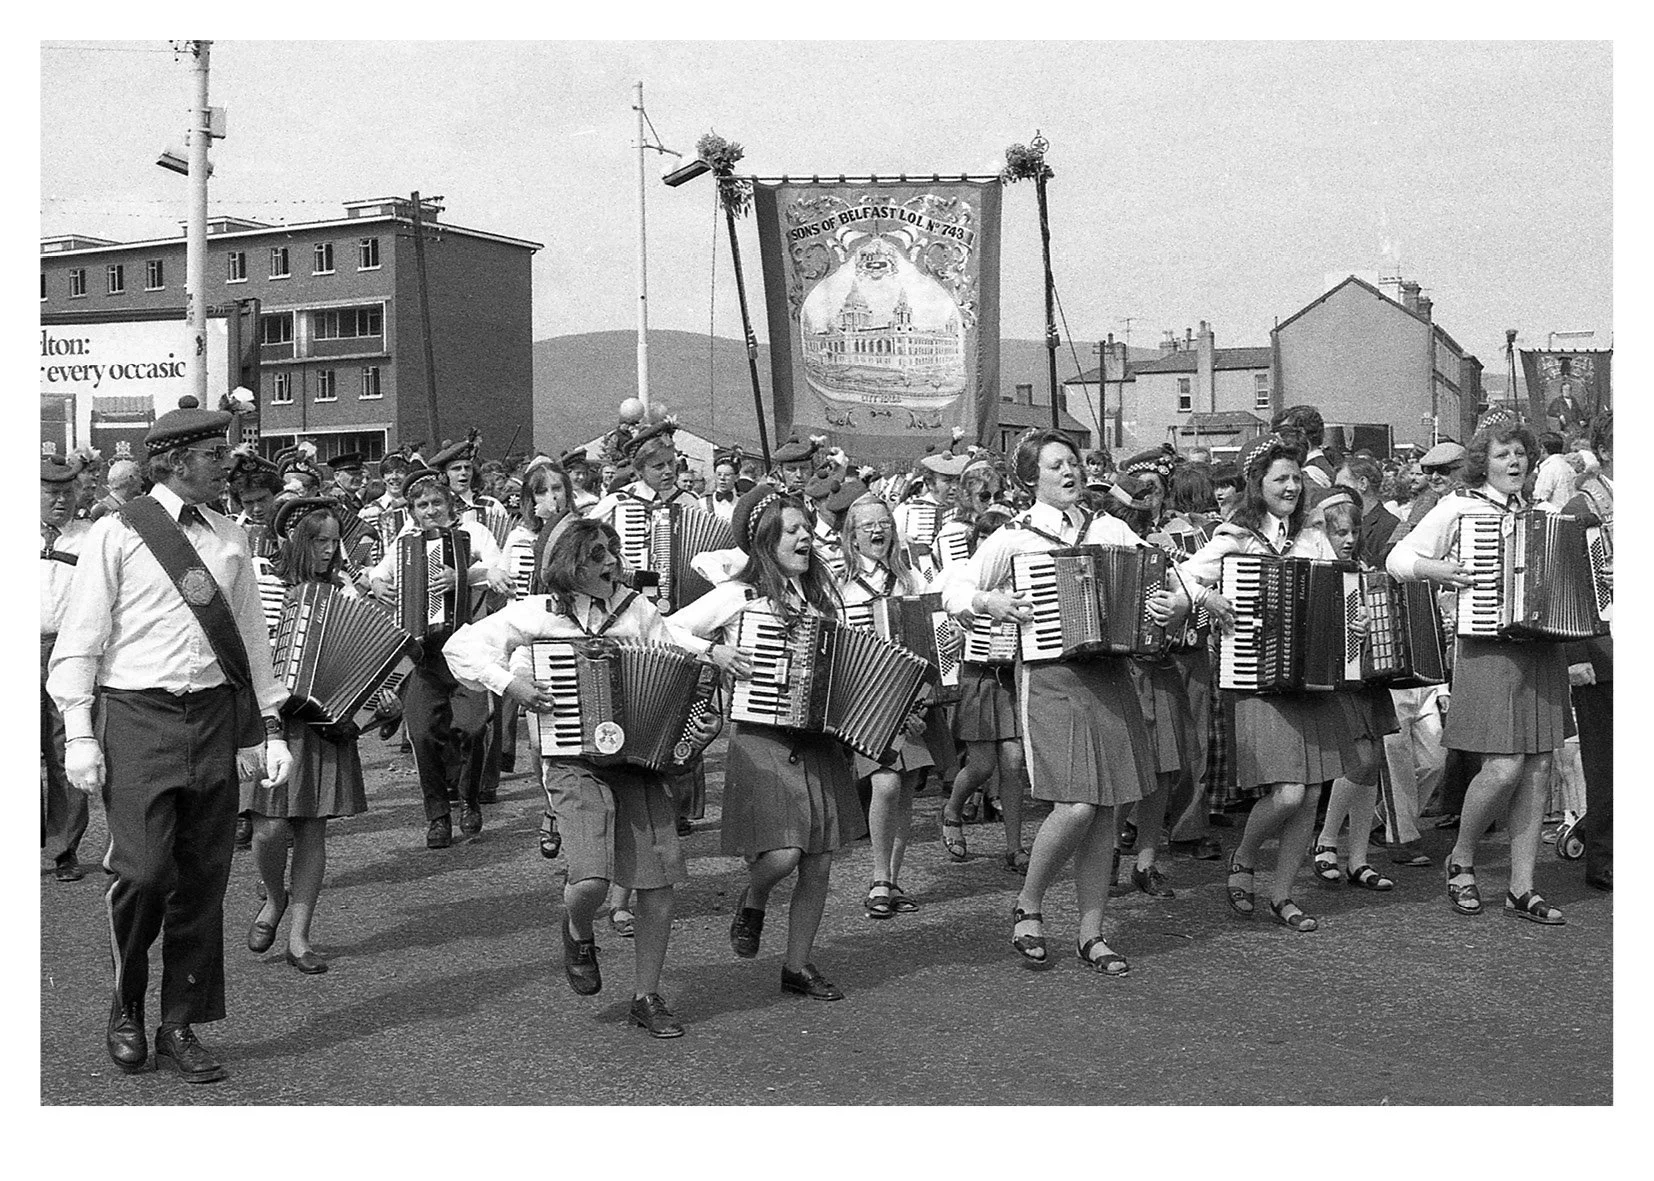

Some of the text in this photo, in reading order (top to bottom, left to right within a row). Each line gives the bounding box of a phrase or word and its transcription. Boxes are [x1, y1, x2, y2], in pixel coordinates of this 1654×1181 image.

[790, 223, 820, 241] SONS
[821, 216, 836, 231] OF
[838, 206, 897, 225] BELFAST
[941, 224, 965, 240] 743
[40, 329, 90, 356] lton:
[47, 364, 106, 389] every
